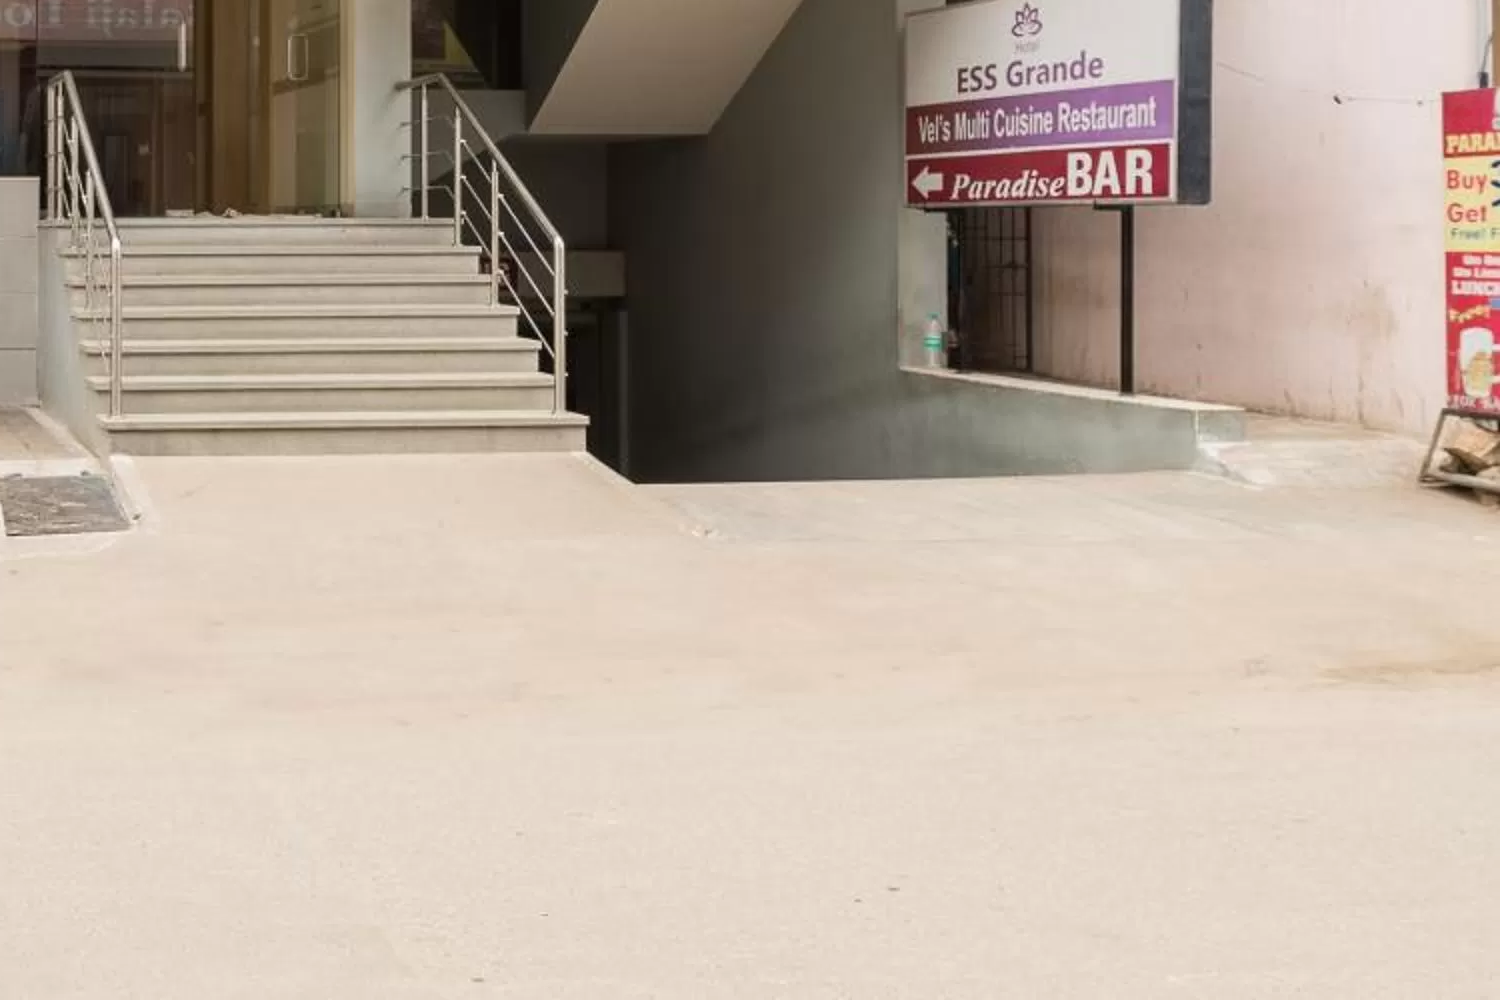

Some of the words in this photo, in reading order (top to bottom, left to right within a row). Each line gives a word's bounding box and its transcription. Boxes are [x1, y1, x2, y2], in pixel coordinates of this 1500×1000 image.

[957, 64, 997, 93] ESS
[1006, 50, 1104, 88] Grande
[918, 114, 950, 144] Vel's
[954, 110, 990, 140] Multi
[993, 106, 1053, 138] Cuisine
[1057, 96, 1156, 133] Restaurant
[950, 170, 1065, 200] Paradise
[1066, 148, 1154, 196] BAR
[1446, 169, 1487, 194] Buy
[1446, 203, 1487, 223] Get
